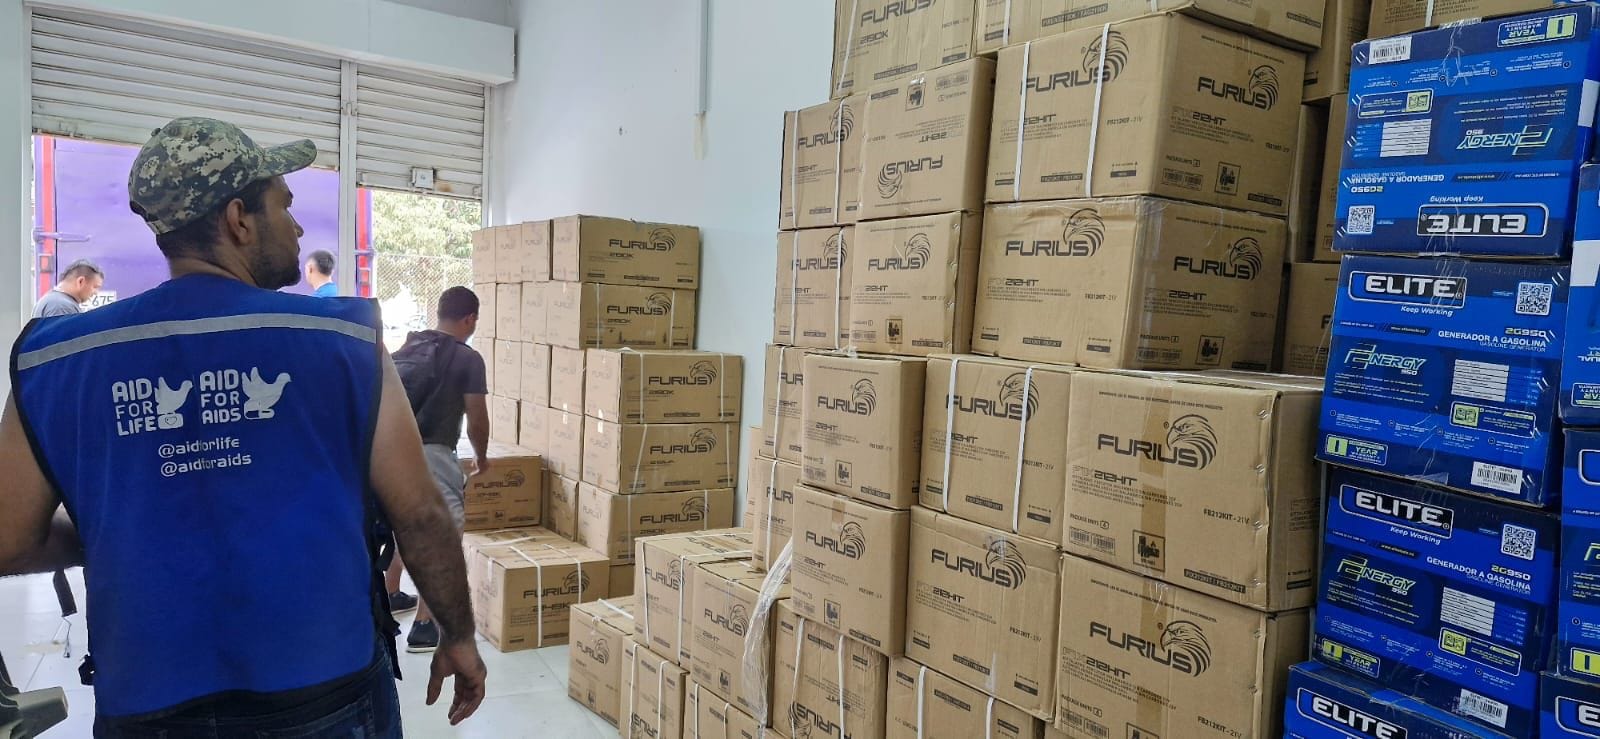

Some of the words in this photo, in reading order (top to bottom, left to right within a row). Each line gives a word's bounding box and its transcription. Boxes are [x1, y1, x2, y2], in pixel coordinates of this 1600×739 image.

[1509, 29, 1536, 38] YEAR
[1020, 65, 1110, 95] FURIUS
[1198, 77, 1267, 110] FURIUS
[798, 130, 845, 149] FURIUS
[886, 155, 943, 175] FURIUS
[1351, 176, 1388, 184] GASOLINA
[1396, 174, 1445, 182] GENERADOR
[1430, 195, 1462, 203] Working
[1427, 214, 1527, 234] ELITE
[609, 238, 667, 251] FURIUS
[1005, 240, 1089, 256] FURIUS
[791, 257, 839, 271] FURIUS
[868, 257, 921, 271] FURIUS
[1174, 256, 1250, 280] FURIUS
[1365, 275, 1457, 298] ELITE
[607, 305, 665, 316] FURIUS
[1401, 306, 1419, 314] Keep
[1421, 307, 1453, 317] Working
[1438, 330, 1490, 342] GENERADOR
[1501, 336, 1546, 348] GASOLINA
[1505, 327, 1546, 338] 2G950
[200, 369, 239, 391] AID
[649, 375, 708, 386] FURIUS
[778, 372, 804, 385] FUR
[112, 378, 152, 402] AID
[201, 391, 240, 408] FOR
[115, 401, 154, 419] FOR
[818, 396, 867, 416] FURIUS
[946, 394, 1028, 421] FURIUS
[202, 408, 241, 424] AIDS
[117, 416, 157, 436] LIFE
[158, 437, 240, 458] @aidforlife
[650, 443, 708, 455] FURIUS
[1098, 433, 1198, 468] FURIUS
[1355, 446, 1378, 456] YEAR
[160, 454, 252, 477] @aidforaids
[766, 486, 794, 504] FURI
[1356, 491, 1444, 527] ELITE
[640, 513, 700, 525] FURIUS
[806, 530, 858, 559] FURIUS
[1390, 525, 1409, 536] Keep
[1410, 531, 1441, 545] Working
[931, 549, 1011, 588] FURIUS
[1426, 556, 1477, 576] GENERADOR
[1487, 573, 1531, 591] GASOLINA
[1491, 564, 1532, 581] 2G950
[645, 567, 681, 592] FURIUS
[523, 585, 584, 599] FURIUS
[704, 607, 743, 637] FURIUS
[577, 641, 607, 664] FURIUS
[1089, 621, 1192, 674] FURIUS
[1350, 655, 1372, 667] YEAR
[1313, 696, 1398, 739] ELITE
